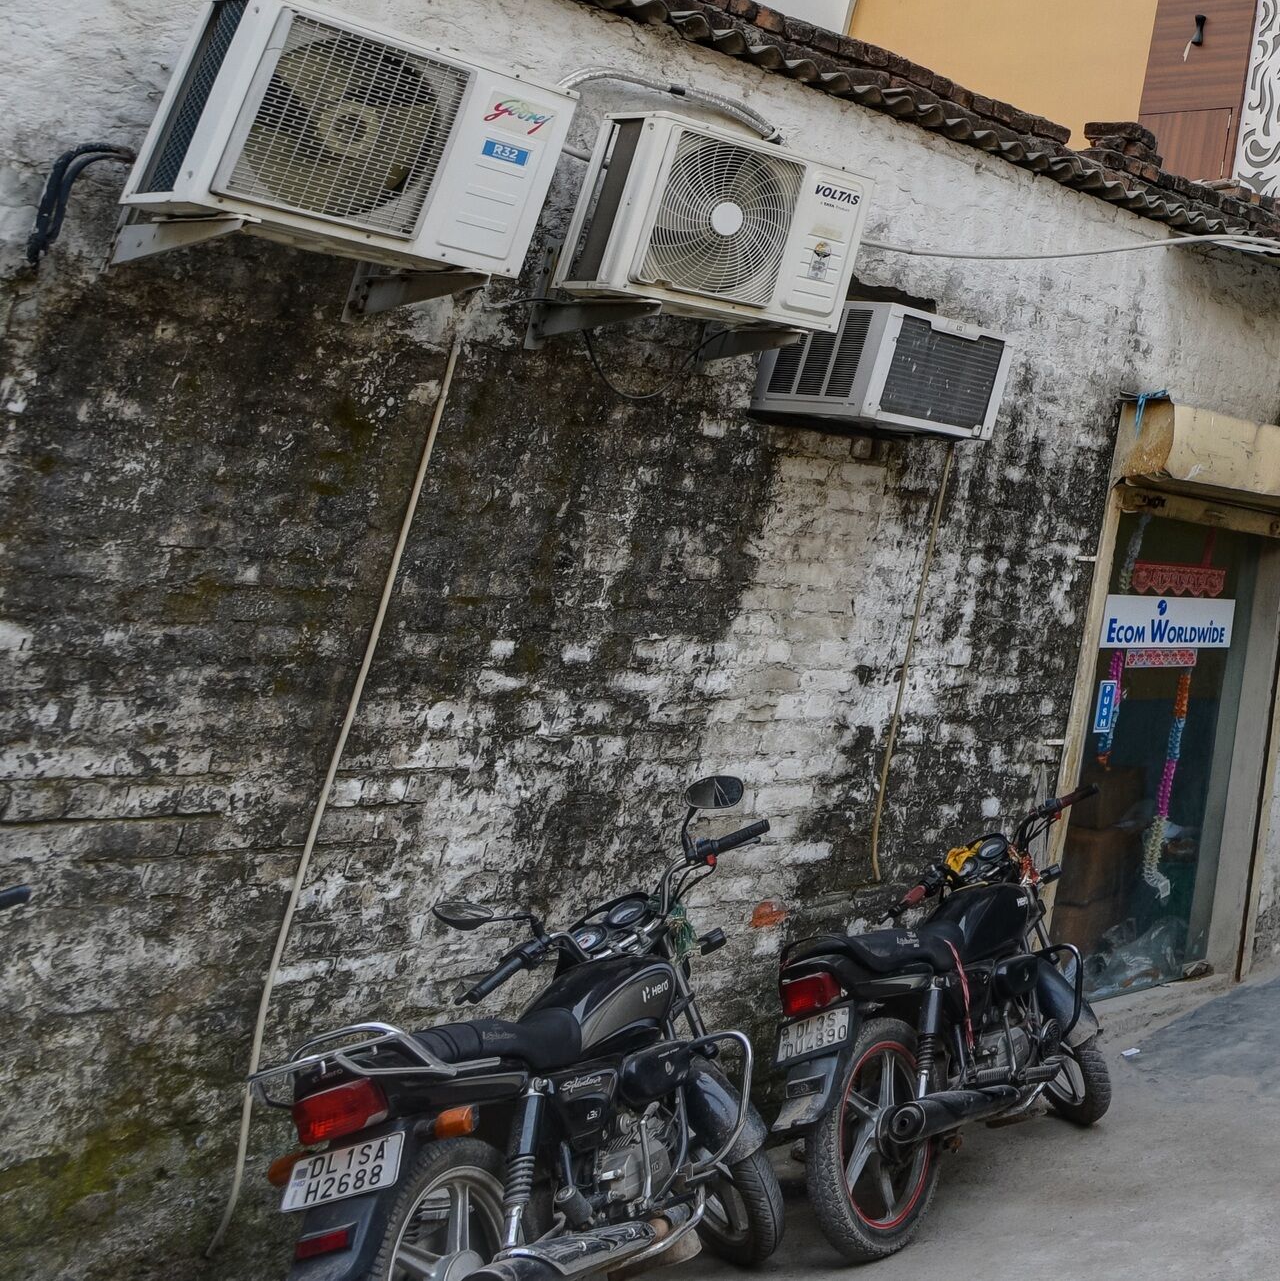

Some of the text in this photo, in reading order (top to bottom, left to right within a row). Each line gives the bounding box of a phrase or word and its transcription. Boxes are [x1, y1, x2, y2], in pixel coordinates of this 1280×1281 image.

[493, 144, 518, 159] R32
[815, 184, 860, 205] VOLTAS
[1100, 686, 1111, 727] PUSH
[310, 1141, 385, 1179] DL 1SA
[304, 1165, 383, 1204] H2688
